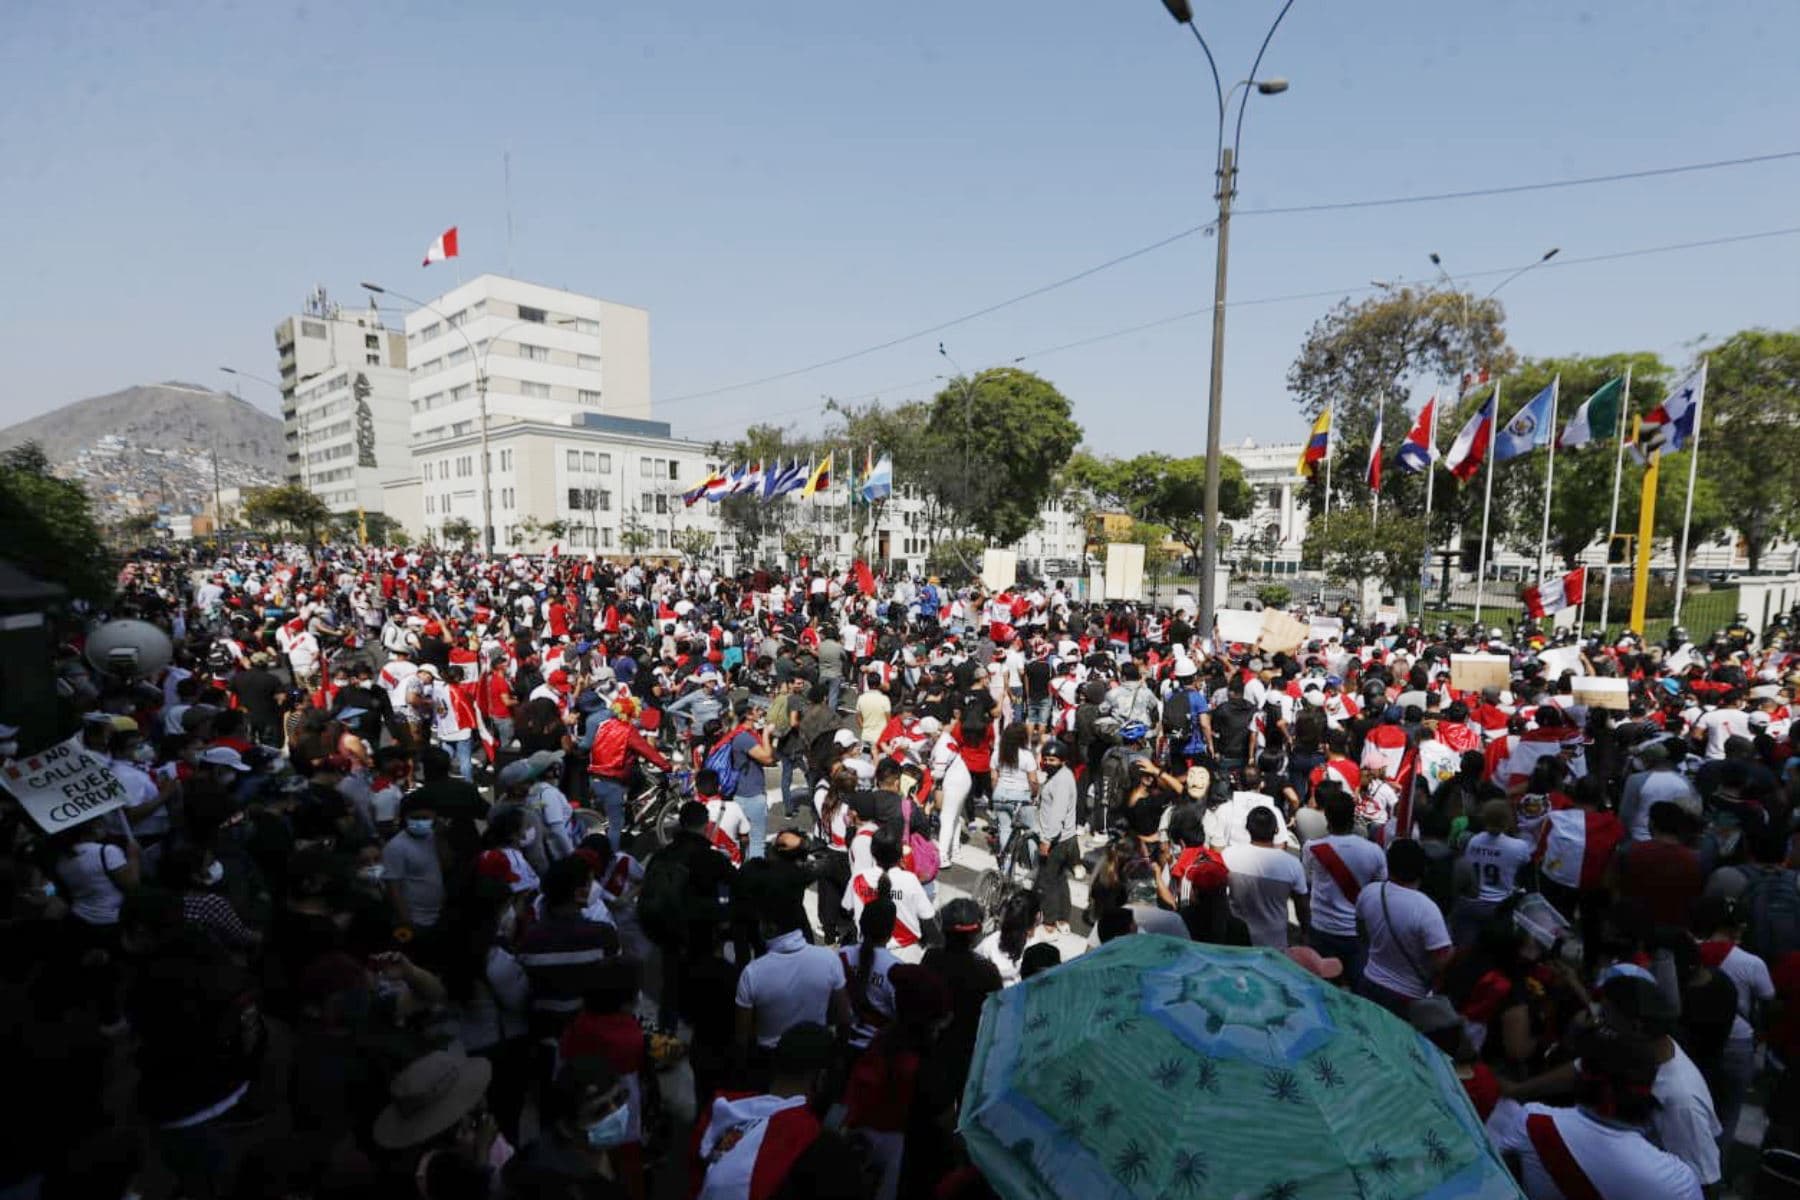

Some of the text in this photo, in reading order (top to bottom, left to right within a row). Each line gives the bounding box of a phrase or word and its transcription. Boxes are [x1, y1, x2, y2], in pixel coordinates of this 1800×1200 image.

[45, 746, 70, 764] NO
[28, 755, 96, 788] CALLA
[1474, 862, 1500, 886] 19
